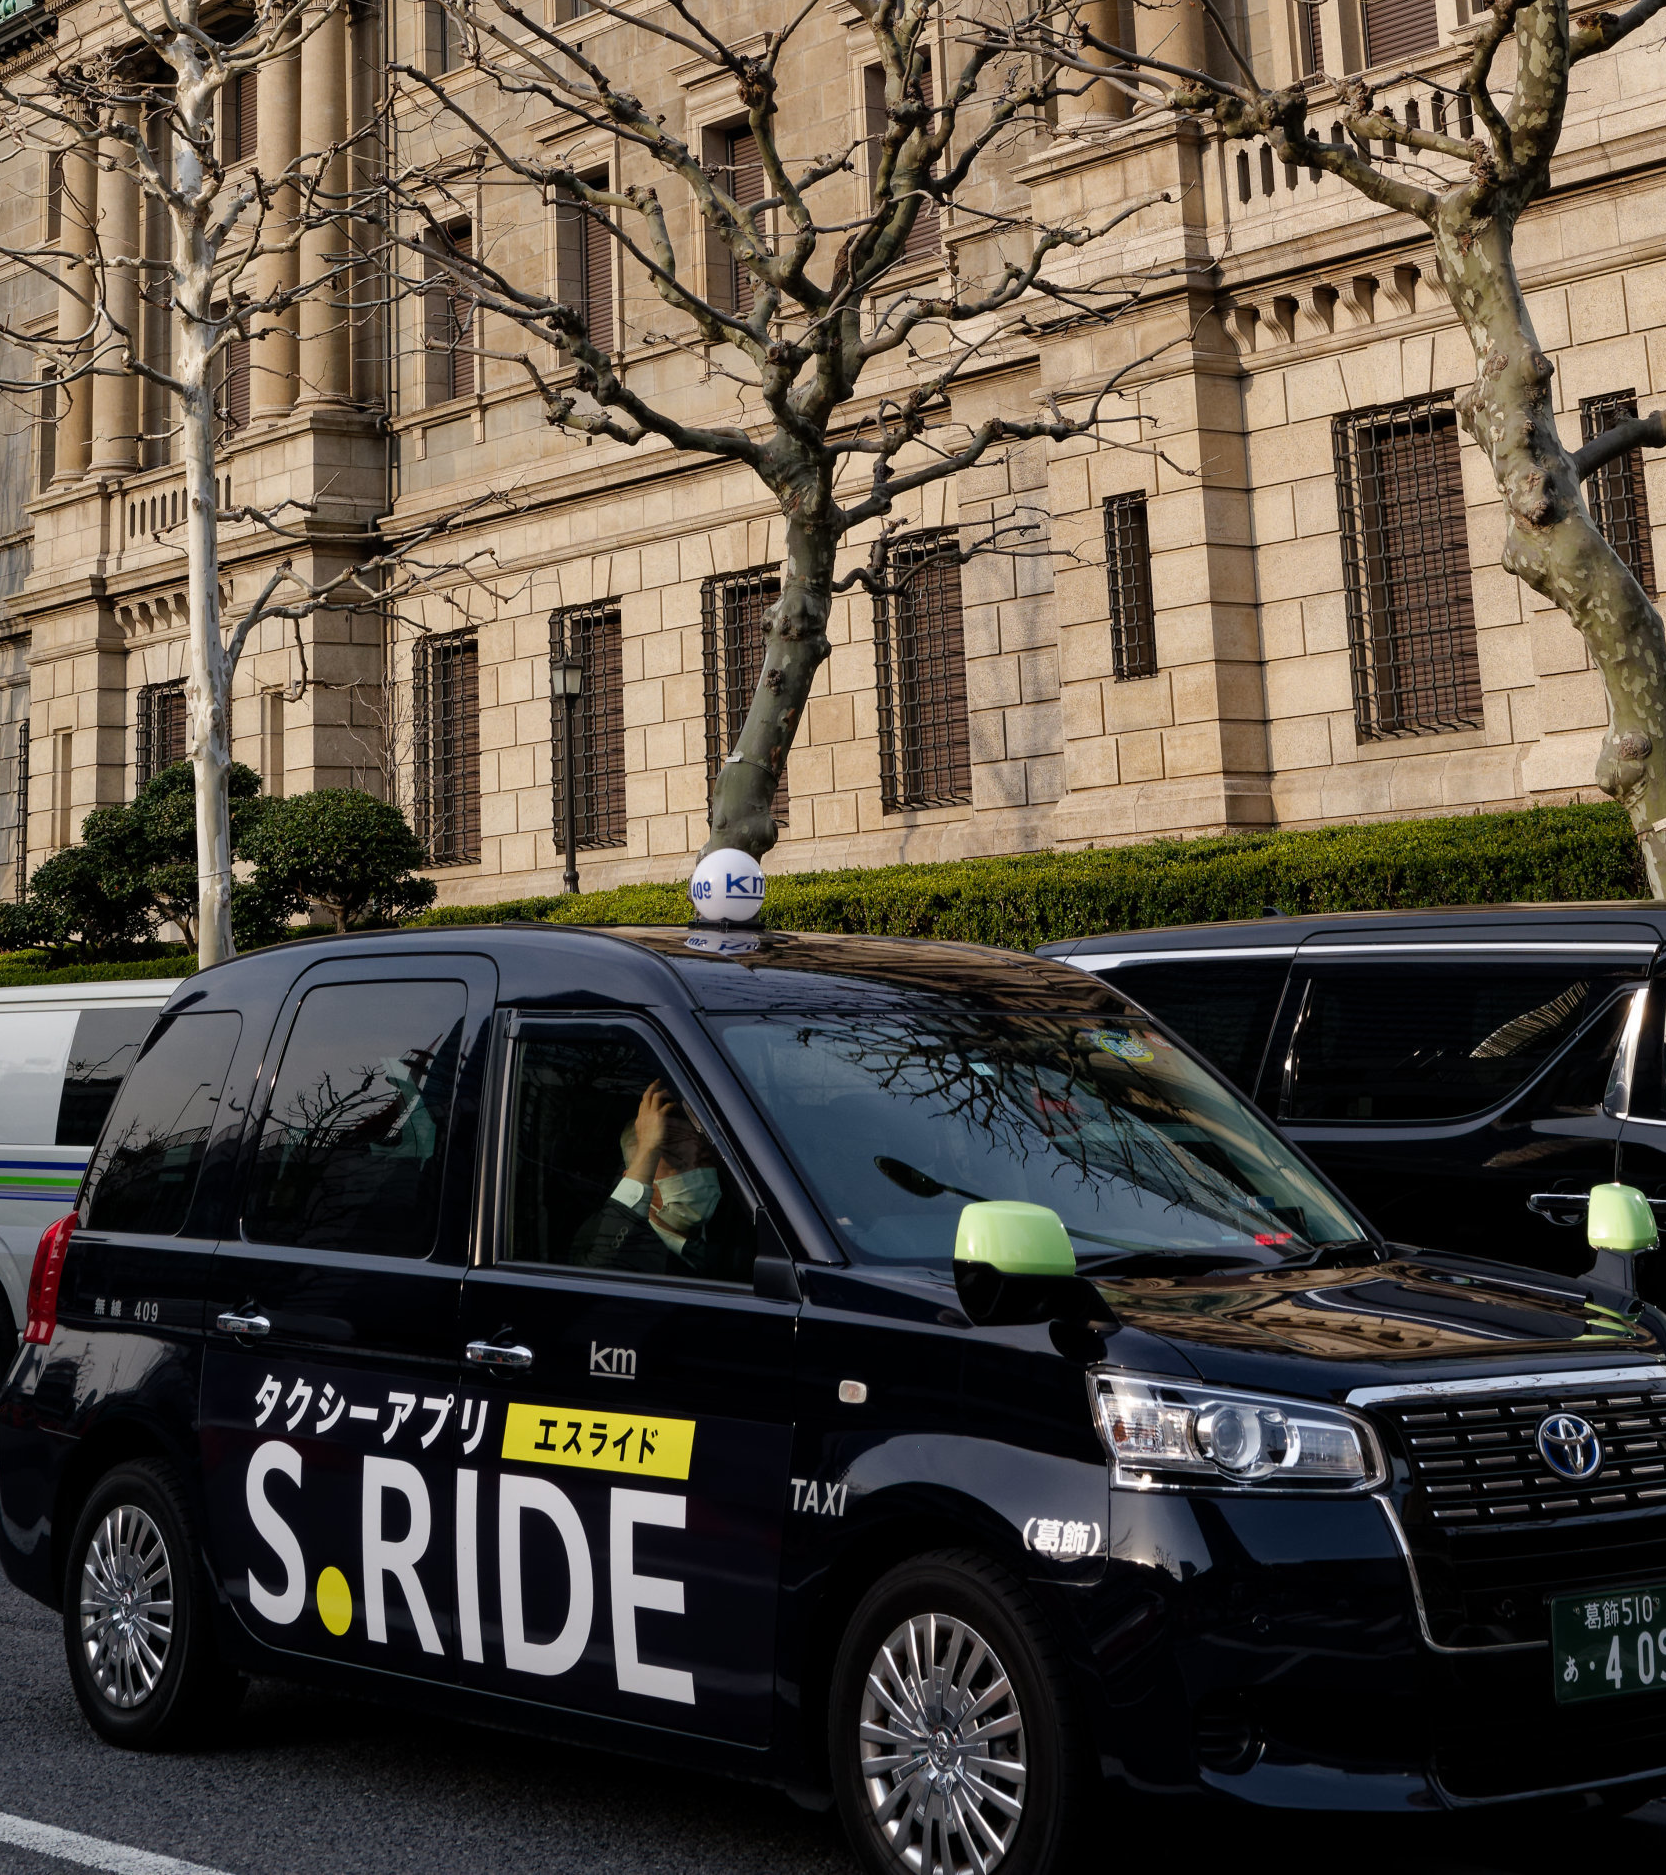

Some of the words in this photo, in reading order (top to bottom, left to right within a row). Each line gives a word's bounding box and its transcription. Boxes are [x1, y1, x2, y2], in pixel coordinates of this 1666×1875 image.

[134, 1301, 159, 1323] 409
[590, 1341, 637, 1377] km
[255, 1374, 489, 1455] タクシーアプリ
[534, 1418, 659, 1464] エスライド
[790, 1478, 848, 1517] TAXI
[246, 1440, 696, 1705] S.RIDE
[1564, 1655, 1579, 1683] あ
